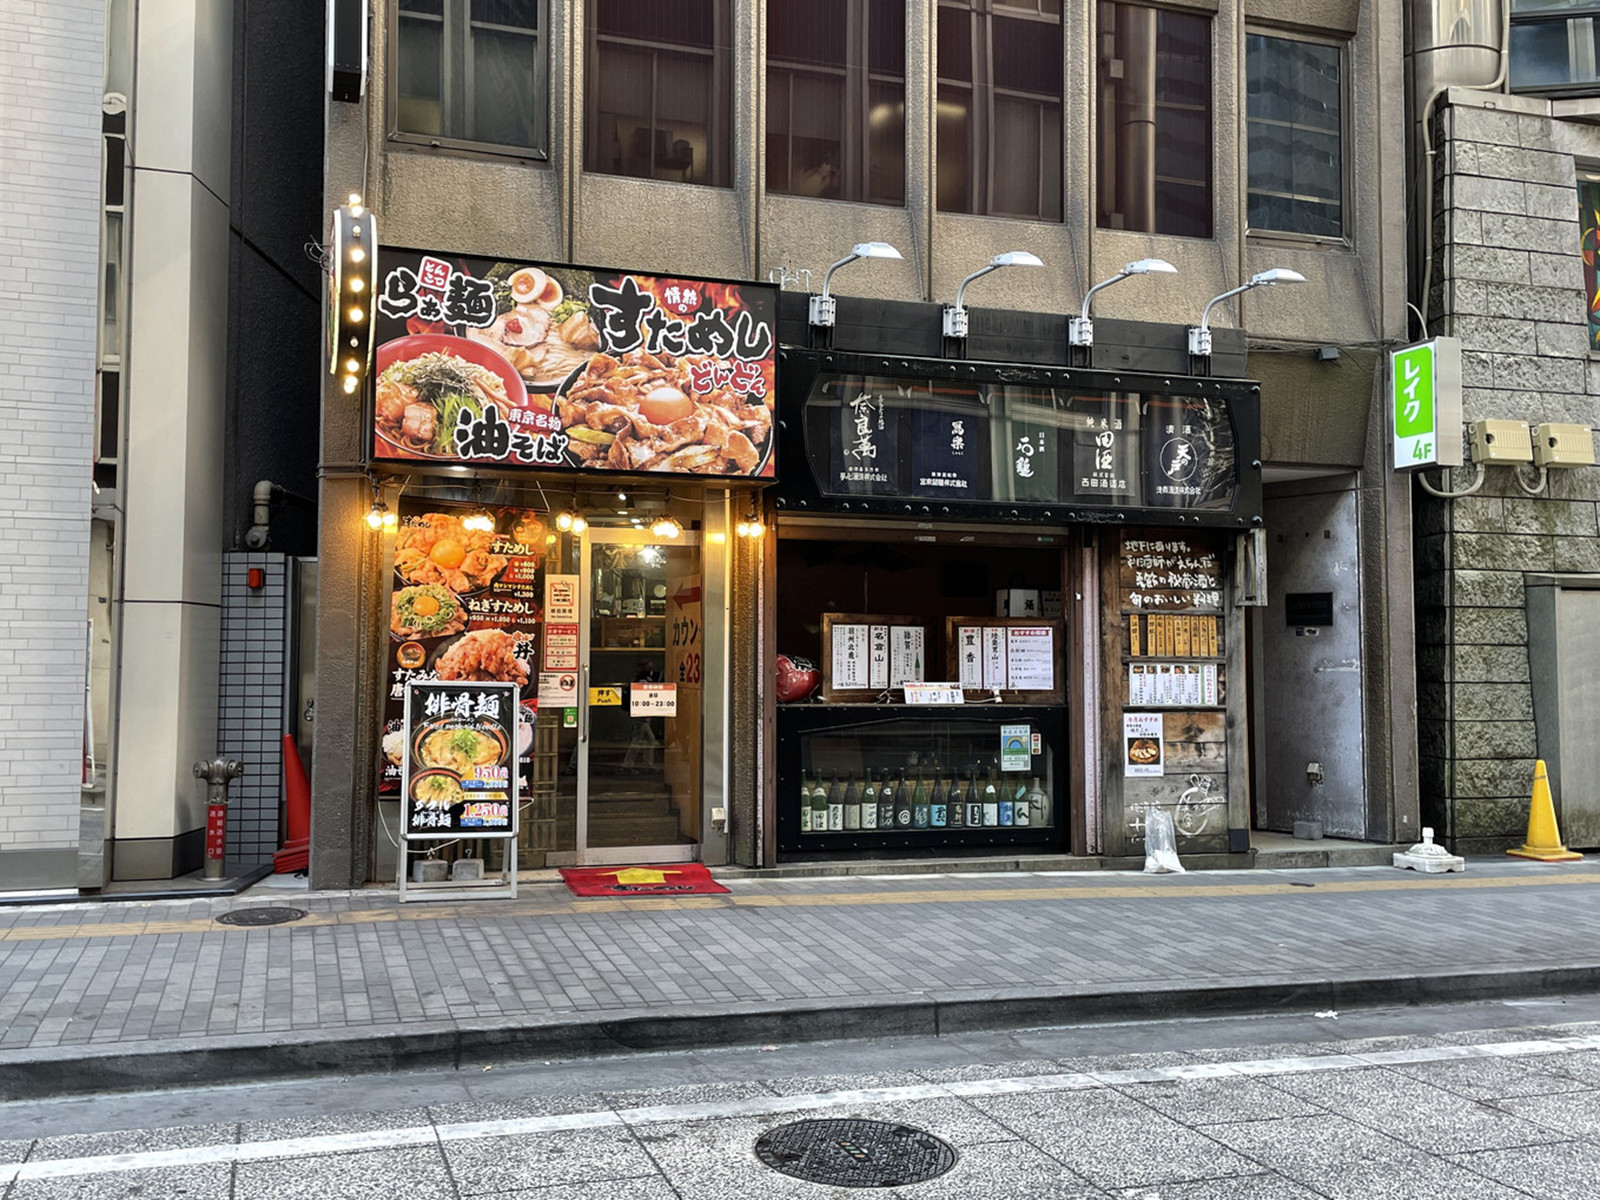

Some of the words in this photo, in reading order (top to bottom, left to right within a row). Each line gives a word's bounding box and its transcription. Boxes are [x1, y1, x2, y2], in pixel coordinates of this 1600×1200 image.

[424, 261, 446, 277] とん
[423, 276, 444, 287] こつ
[664, 286, 698, 305] 情熱
[589, 276, 773, 361] すためし
[678, 304, 688, 313] の
[690, 361, 767, 398] どんどん
[1403, 359, 1421, 423] レイク
[509, 408, 561, 431] 東京名物
[1086, 416, 1122, 430] 純米酒
[455, 404, 569, 462] 油そば
[1095, 431, 1115, 470] 田酒
[1413, 439, 1432, 460] 4F
[492, 541, 535, 556] すためし
[468, 599, 535, 614] ねぎすためし
[673, 616, 701, 647] カウン
[511, 641, 534, 661] 丼
[392, 667, 441, 681] すたみな
